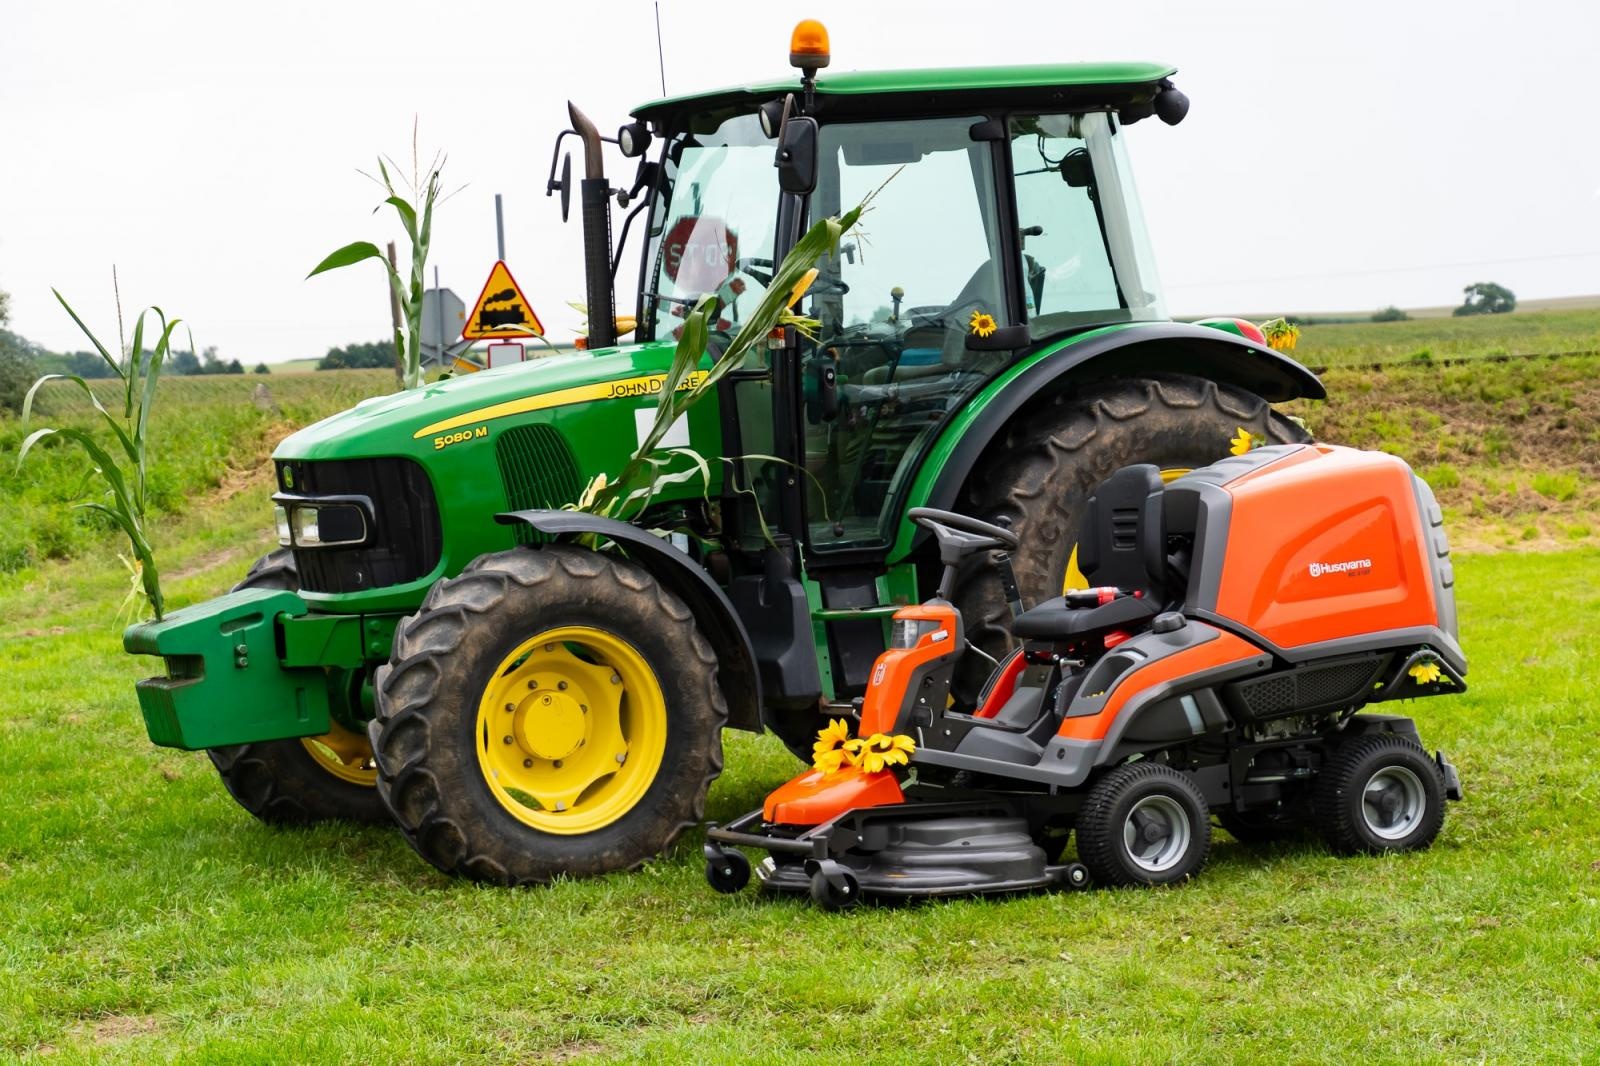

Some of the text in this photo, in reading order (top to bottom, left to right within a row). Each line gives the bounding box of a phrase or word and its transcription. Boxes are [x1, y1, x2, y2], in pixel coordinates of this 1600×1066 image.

[670, 243, 732, 267] STOP
[608, 378, 698, 397] JOHN DRE
[434, 425, 488, 450] 5080 M
[1320, 559, 1371, 573] Husqvarna
